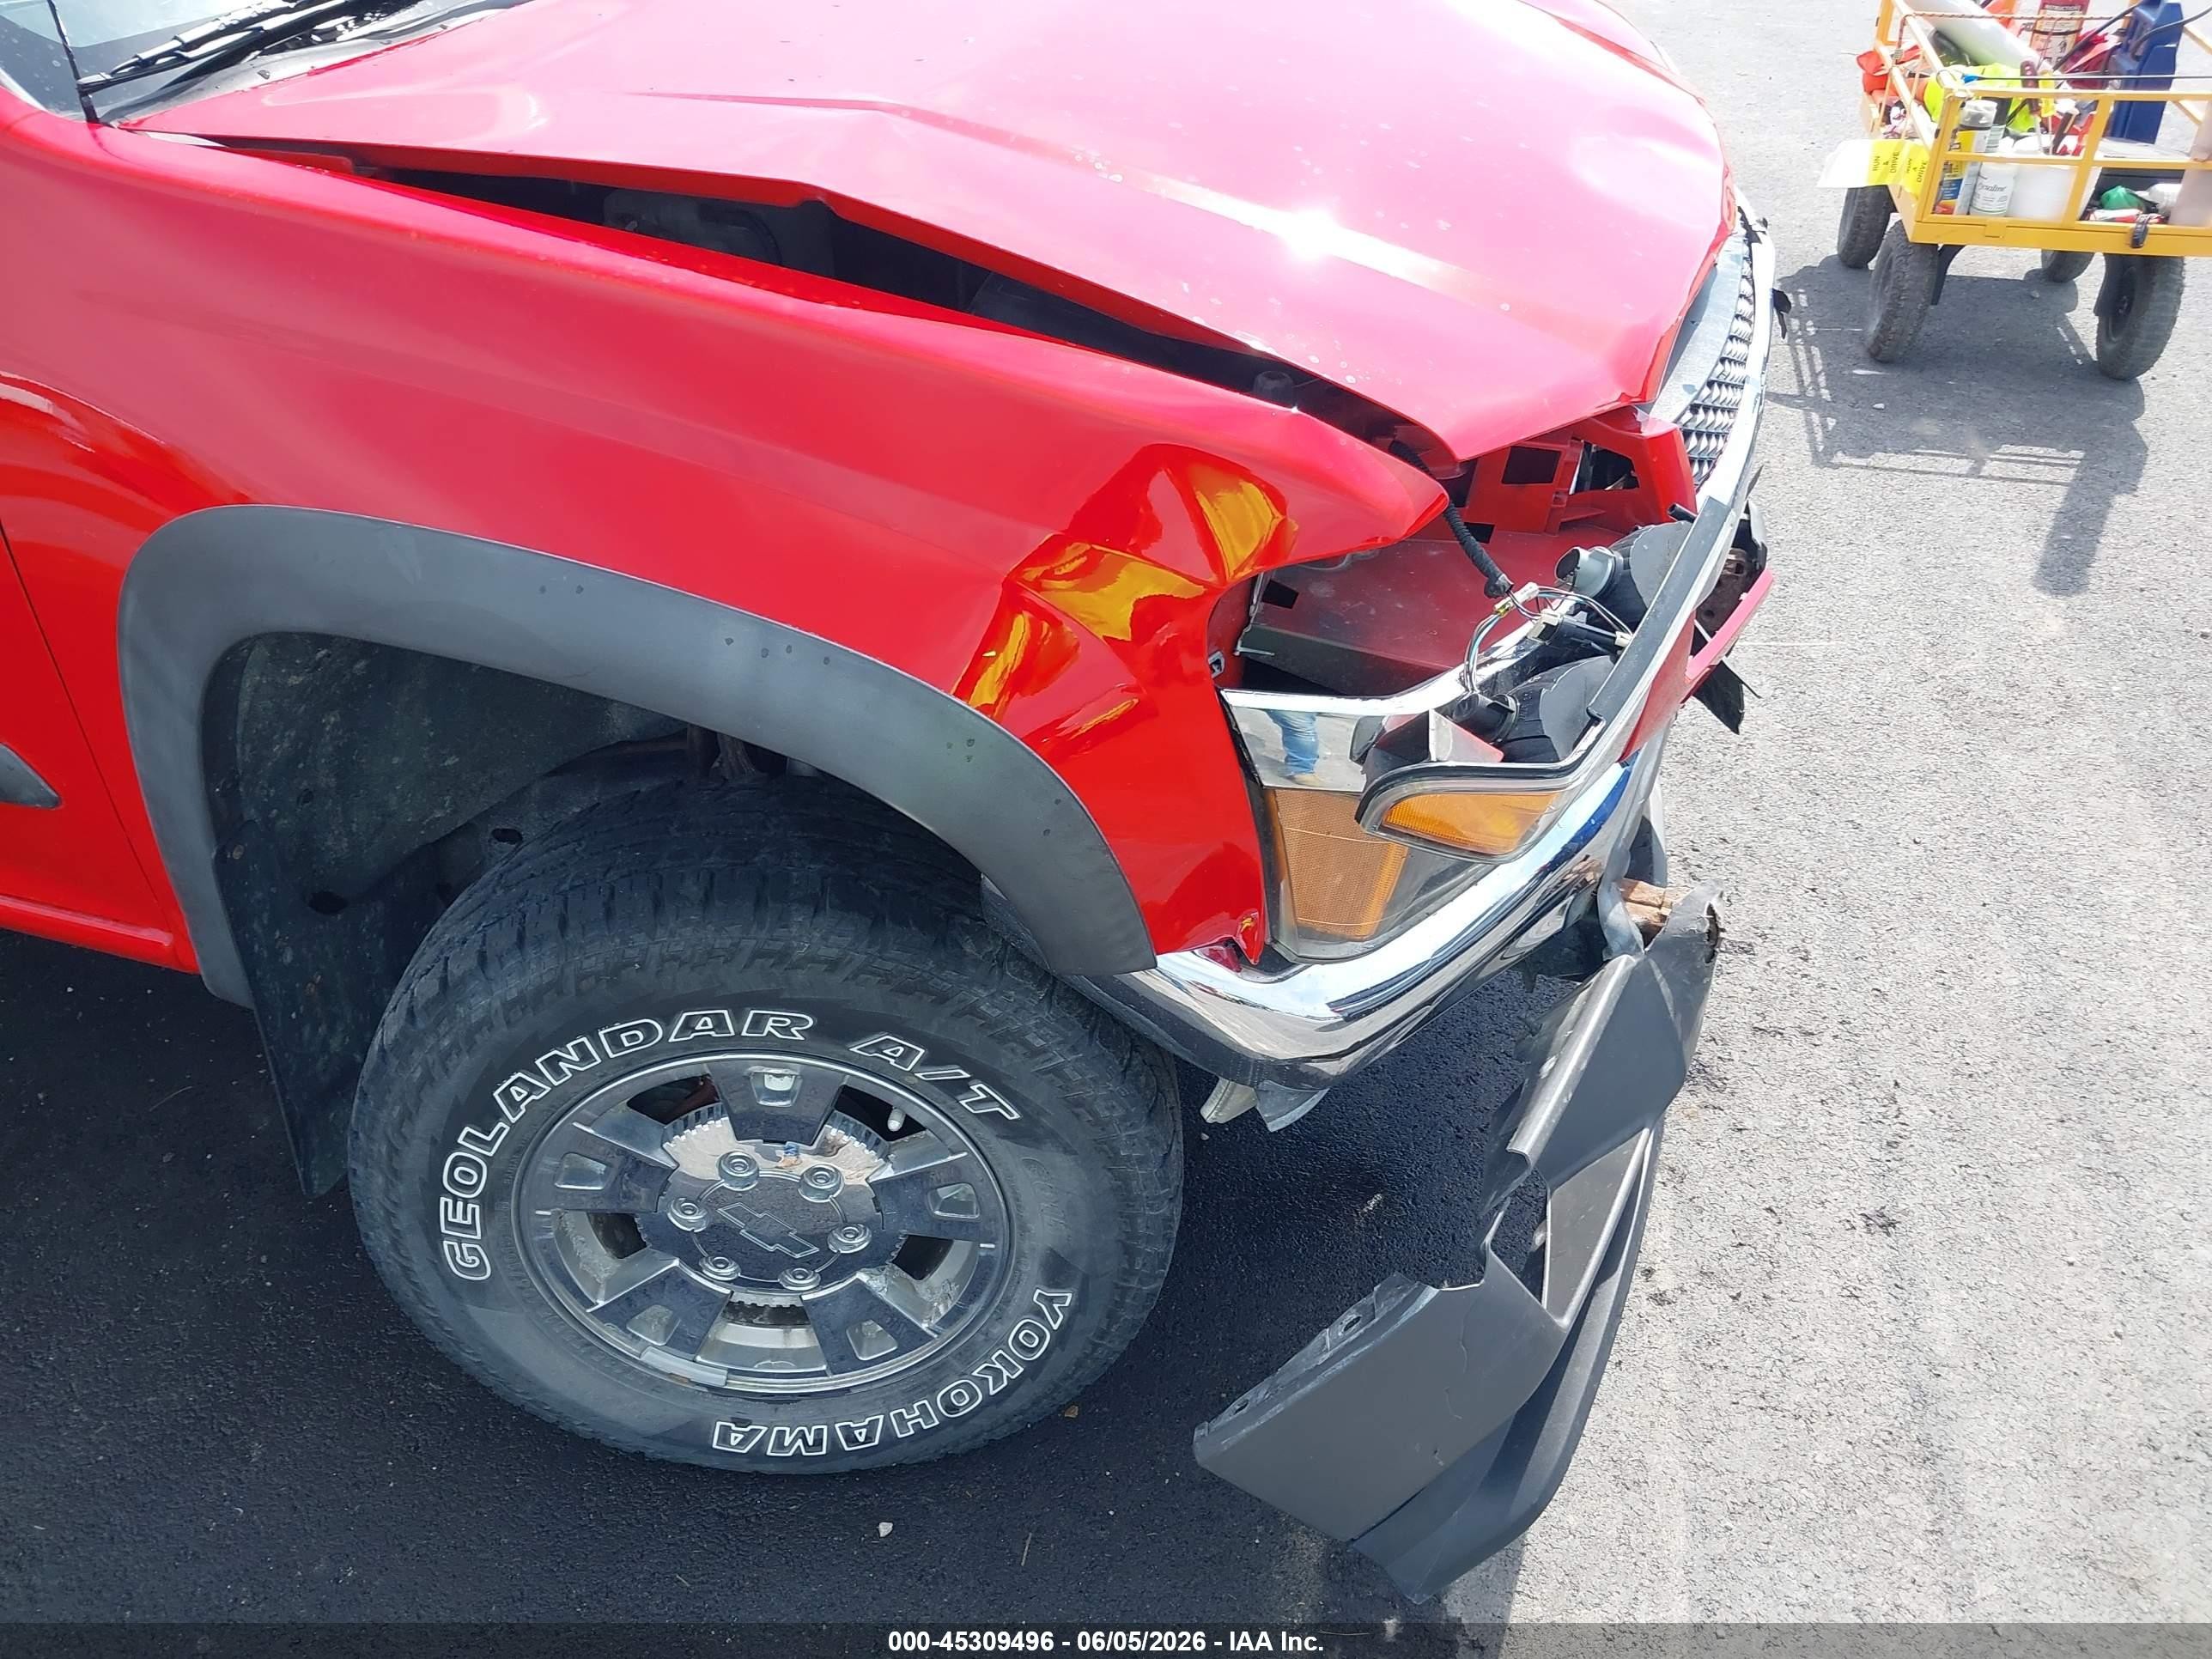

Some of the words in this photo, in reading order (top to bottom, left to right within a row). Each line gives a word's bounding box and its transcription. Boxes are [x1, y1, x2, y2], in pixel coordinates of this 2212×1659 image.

[1889, 151, 1900, 173] DRIVE
[437, 1009, 815, 1281] GEOLANDAR
[851, 1033, 1023, 1121] A/T
[711, 1287, 1073, 1457] YOKOHAMA
